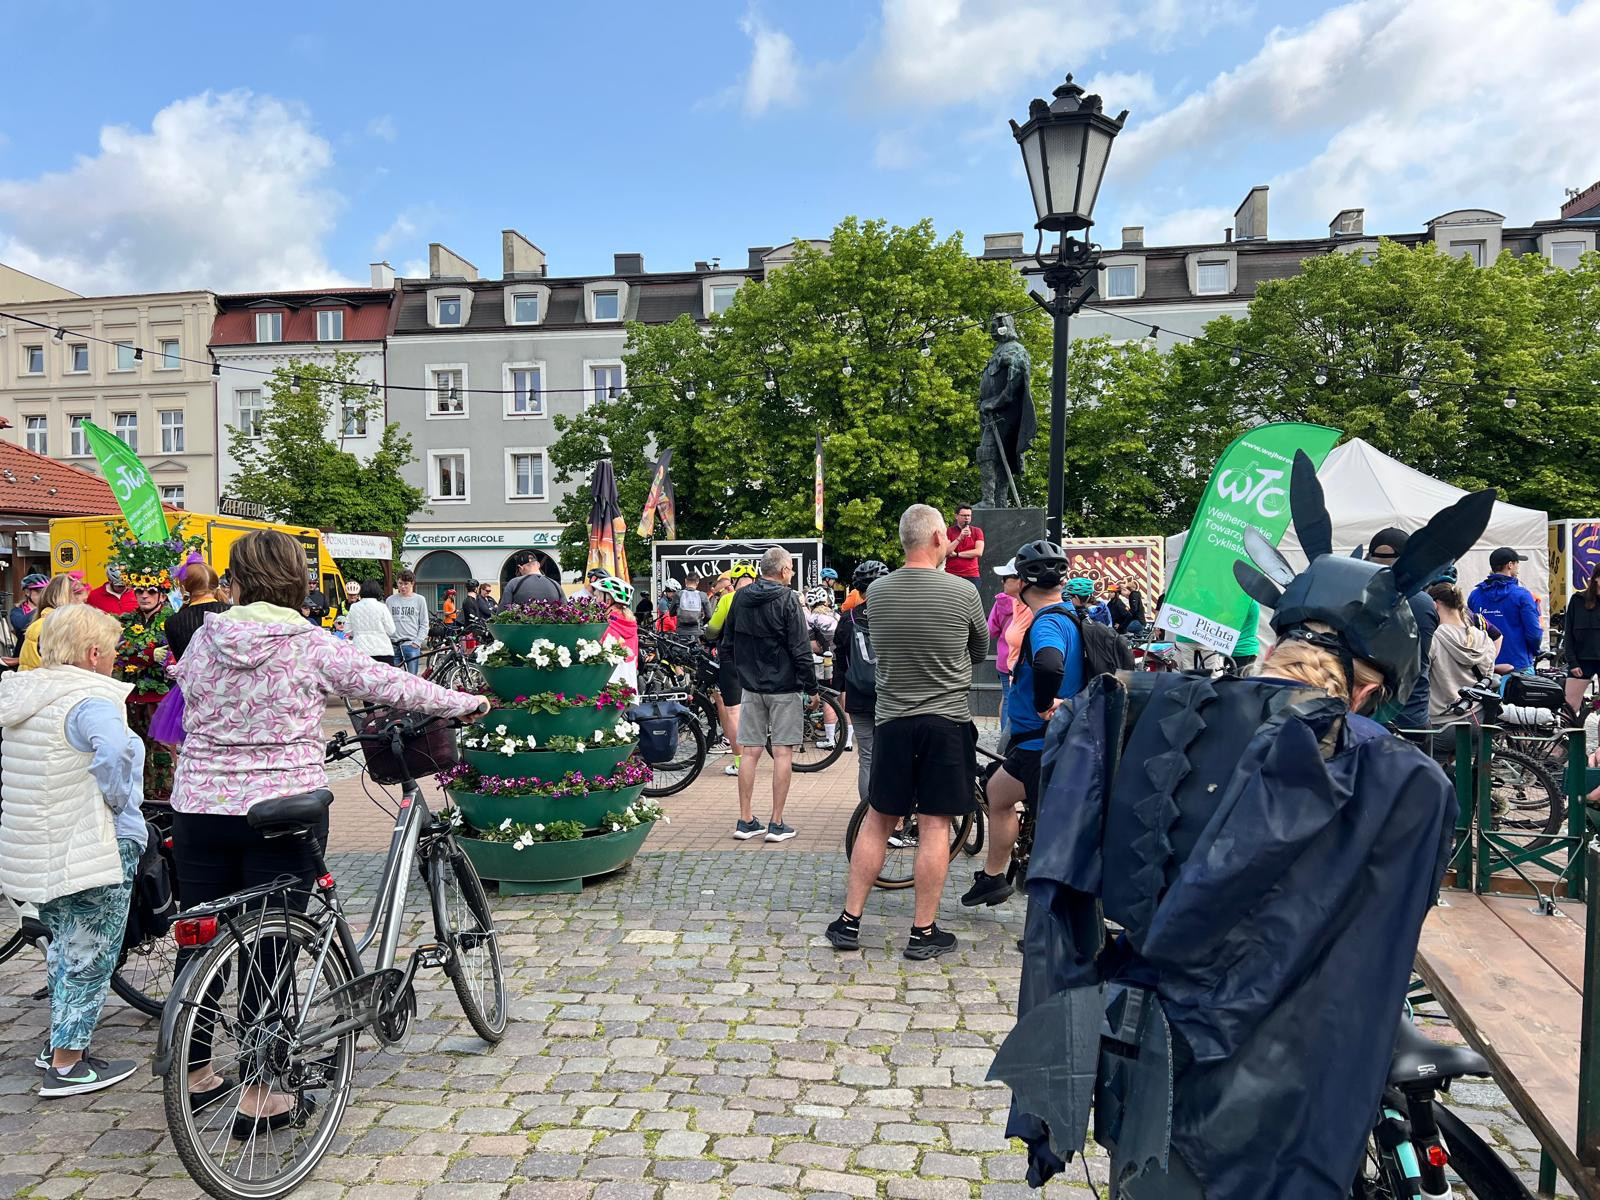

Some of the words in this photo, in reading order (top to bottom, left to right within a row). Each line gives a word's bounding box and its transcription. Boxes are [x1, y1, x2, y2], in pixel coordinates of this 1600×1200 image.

[1217, 468, 1285, 518] WTC
[422, 534, 456, 543] CRÉDIT
[458, 535, 505, 543] AGRICOLE
[1205, 518, 1244, 542] Towarzy
[681, 560, 724, 580] JACK
[1549, 549, 1560, 574] AS
[1192, 629, 1212, 643] dealer
[1213, 640, 1230, 651] park
[1196, 618, 1234, 642] Plichta
